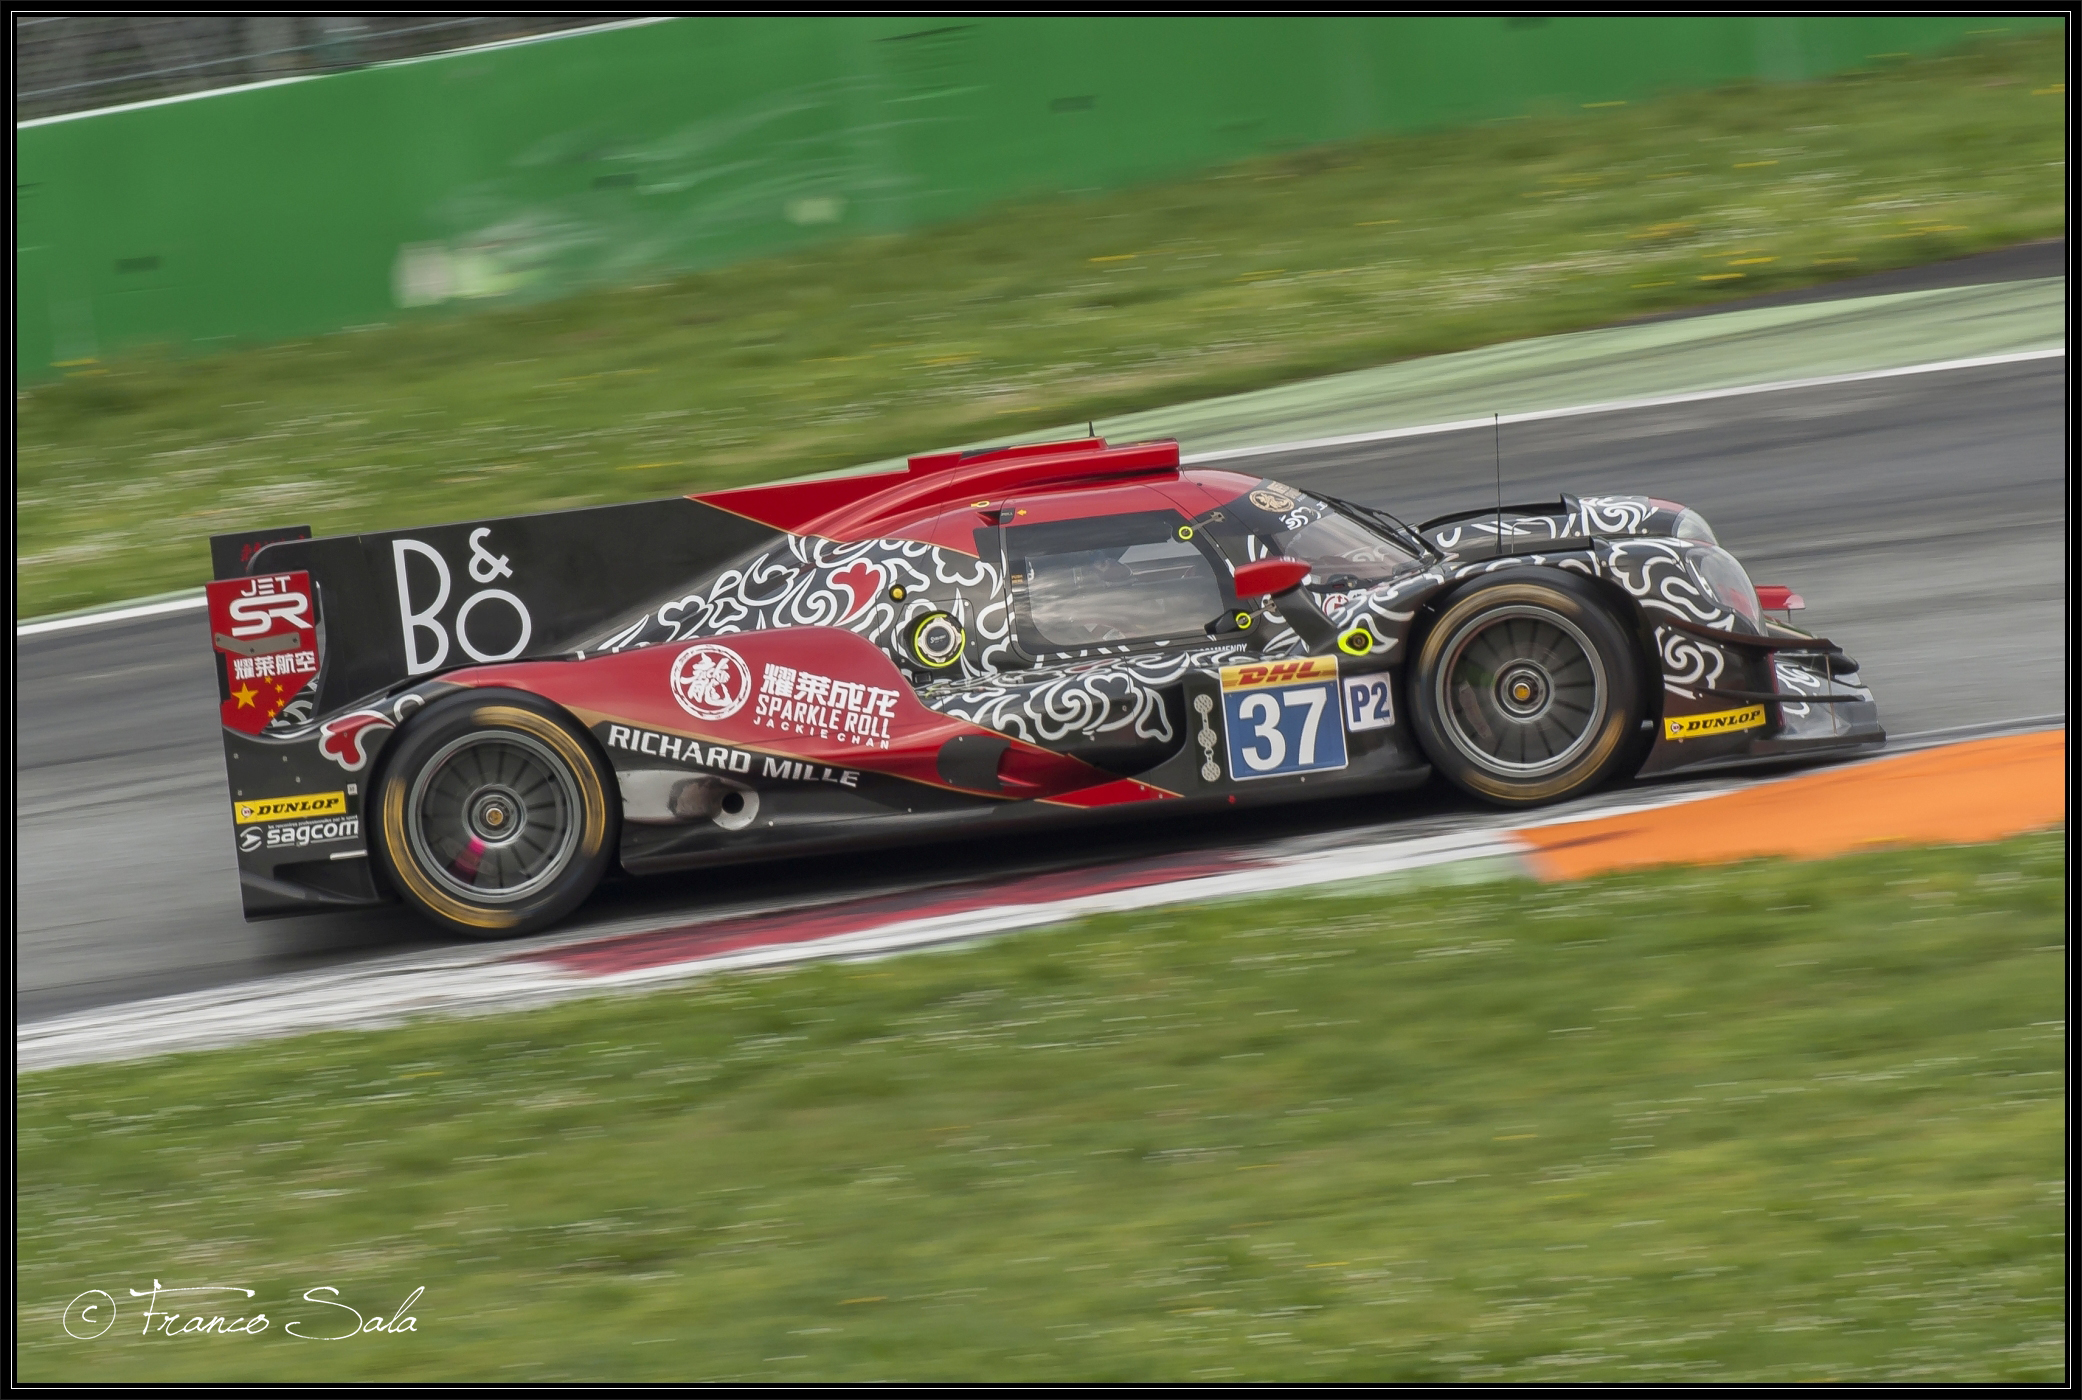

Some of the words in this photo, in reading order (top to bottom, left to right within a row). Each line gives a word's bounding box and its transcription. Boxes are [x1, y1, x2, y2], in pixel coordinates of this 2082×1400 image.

[241, 575, 292, 597] JET
[229, 592, 313, 637] SR
[233, 650, 318, 680] 耀莱航空
[1238, 661, 1321, 685] DHL
[761, 663, 900, 718] 耀莱成龙
[1349, 681, 1391, 723] P2
[752, 716, 830, 740] JACKIE
[836, 732, 891, 751] CHAN
[755, 694, 842, 731] SPARKLE
[844, 715, 892, 740] ROLL
[1238, 687, 1327, 771] 37
[1686, 710, 1761, 731] DUNLOP
[607, 724, 752, 775] RICHARD
[762, 756, 862, 789] MILLE
[258, 798, 339, 815] DUNLOP
[266, 821, 359, 847] sagcom
